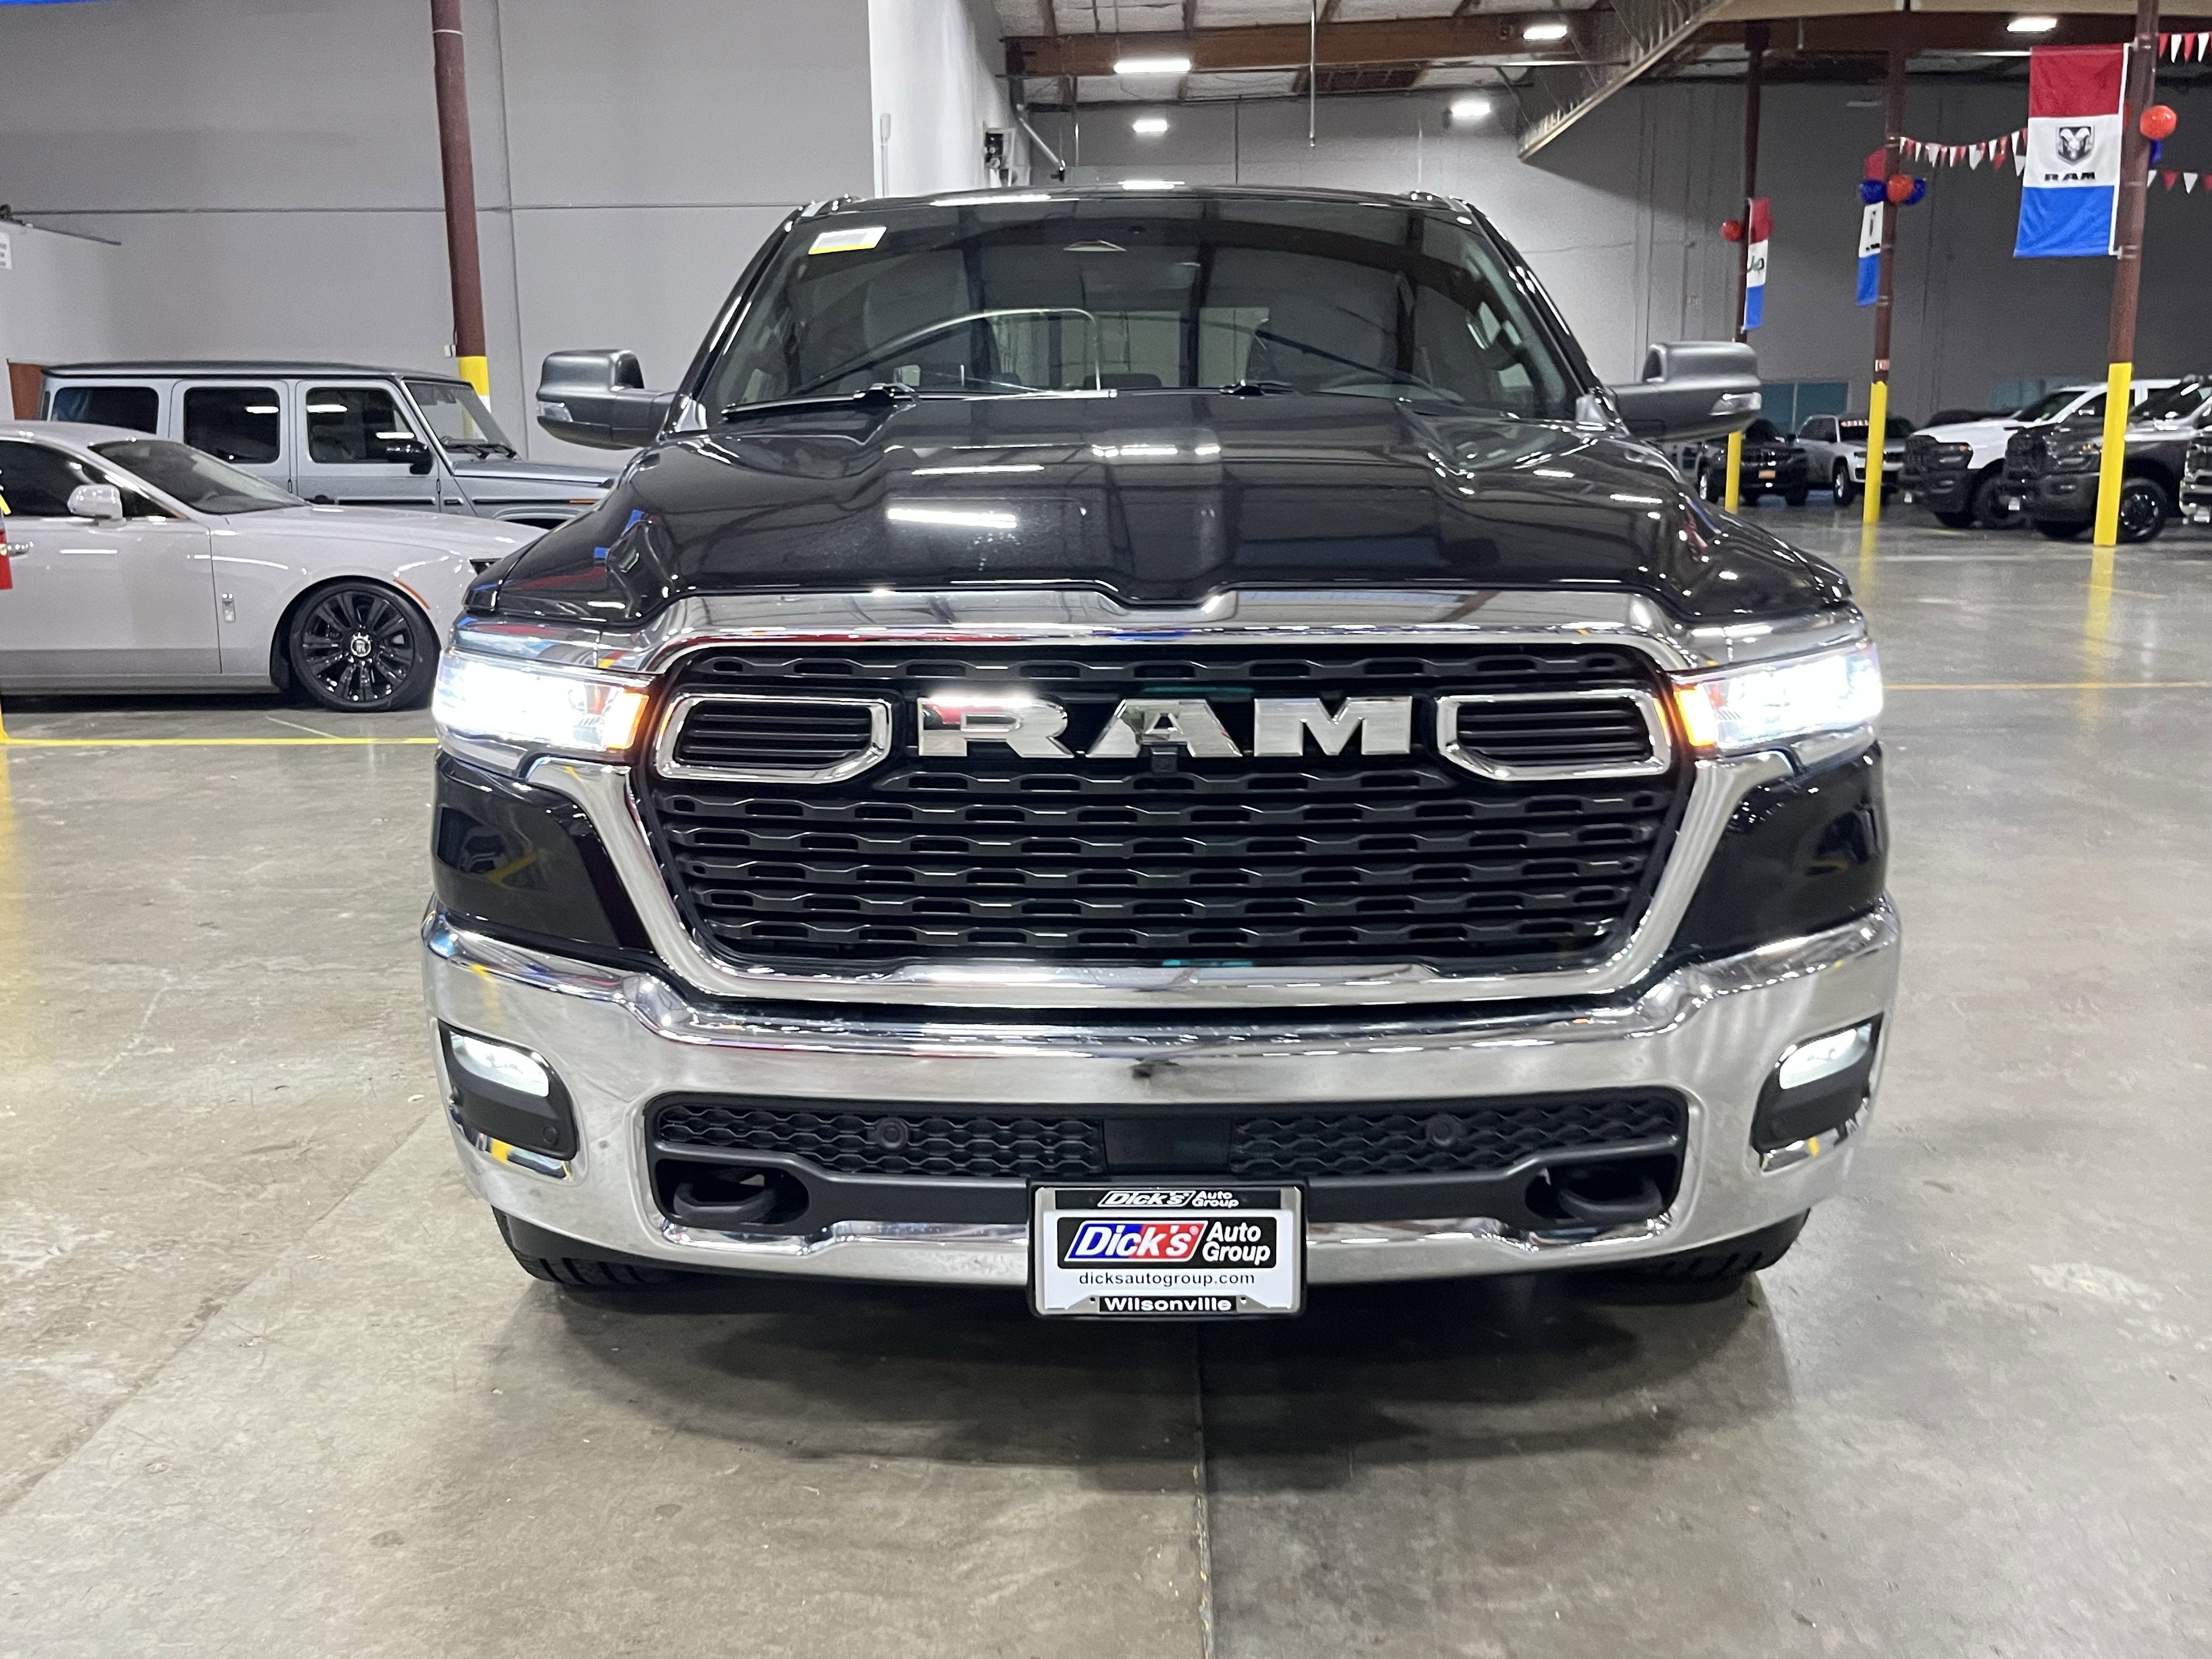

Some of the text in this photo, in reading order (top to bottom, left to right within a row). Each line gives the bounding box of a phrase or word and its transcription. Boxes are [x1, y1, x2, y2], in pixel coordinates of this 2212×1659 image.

[2044, 172, 2095, 181] RAM
[917, 696, 1413, 758] RAM
[1196, 1191, 1233, 1199] Auto
[1192, 1199, 1239, 1207] Group
[1207, 1222, 1261, 1242] Auto
[1076, 1225, 1192, 1256] Dick's
[1202, 1242, 1270, 1265] Group
[1079, 1272, 1255, 1286] dicksautogroup.com
[1105, 1297, 1232, 1312] Wilsonville
